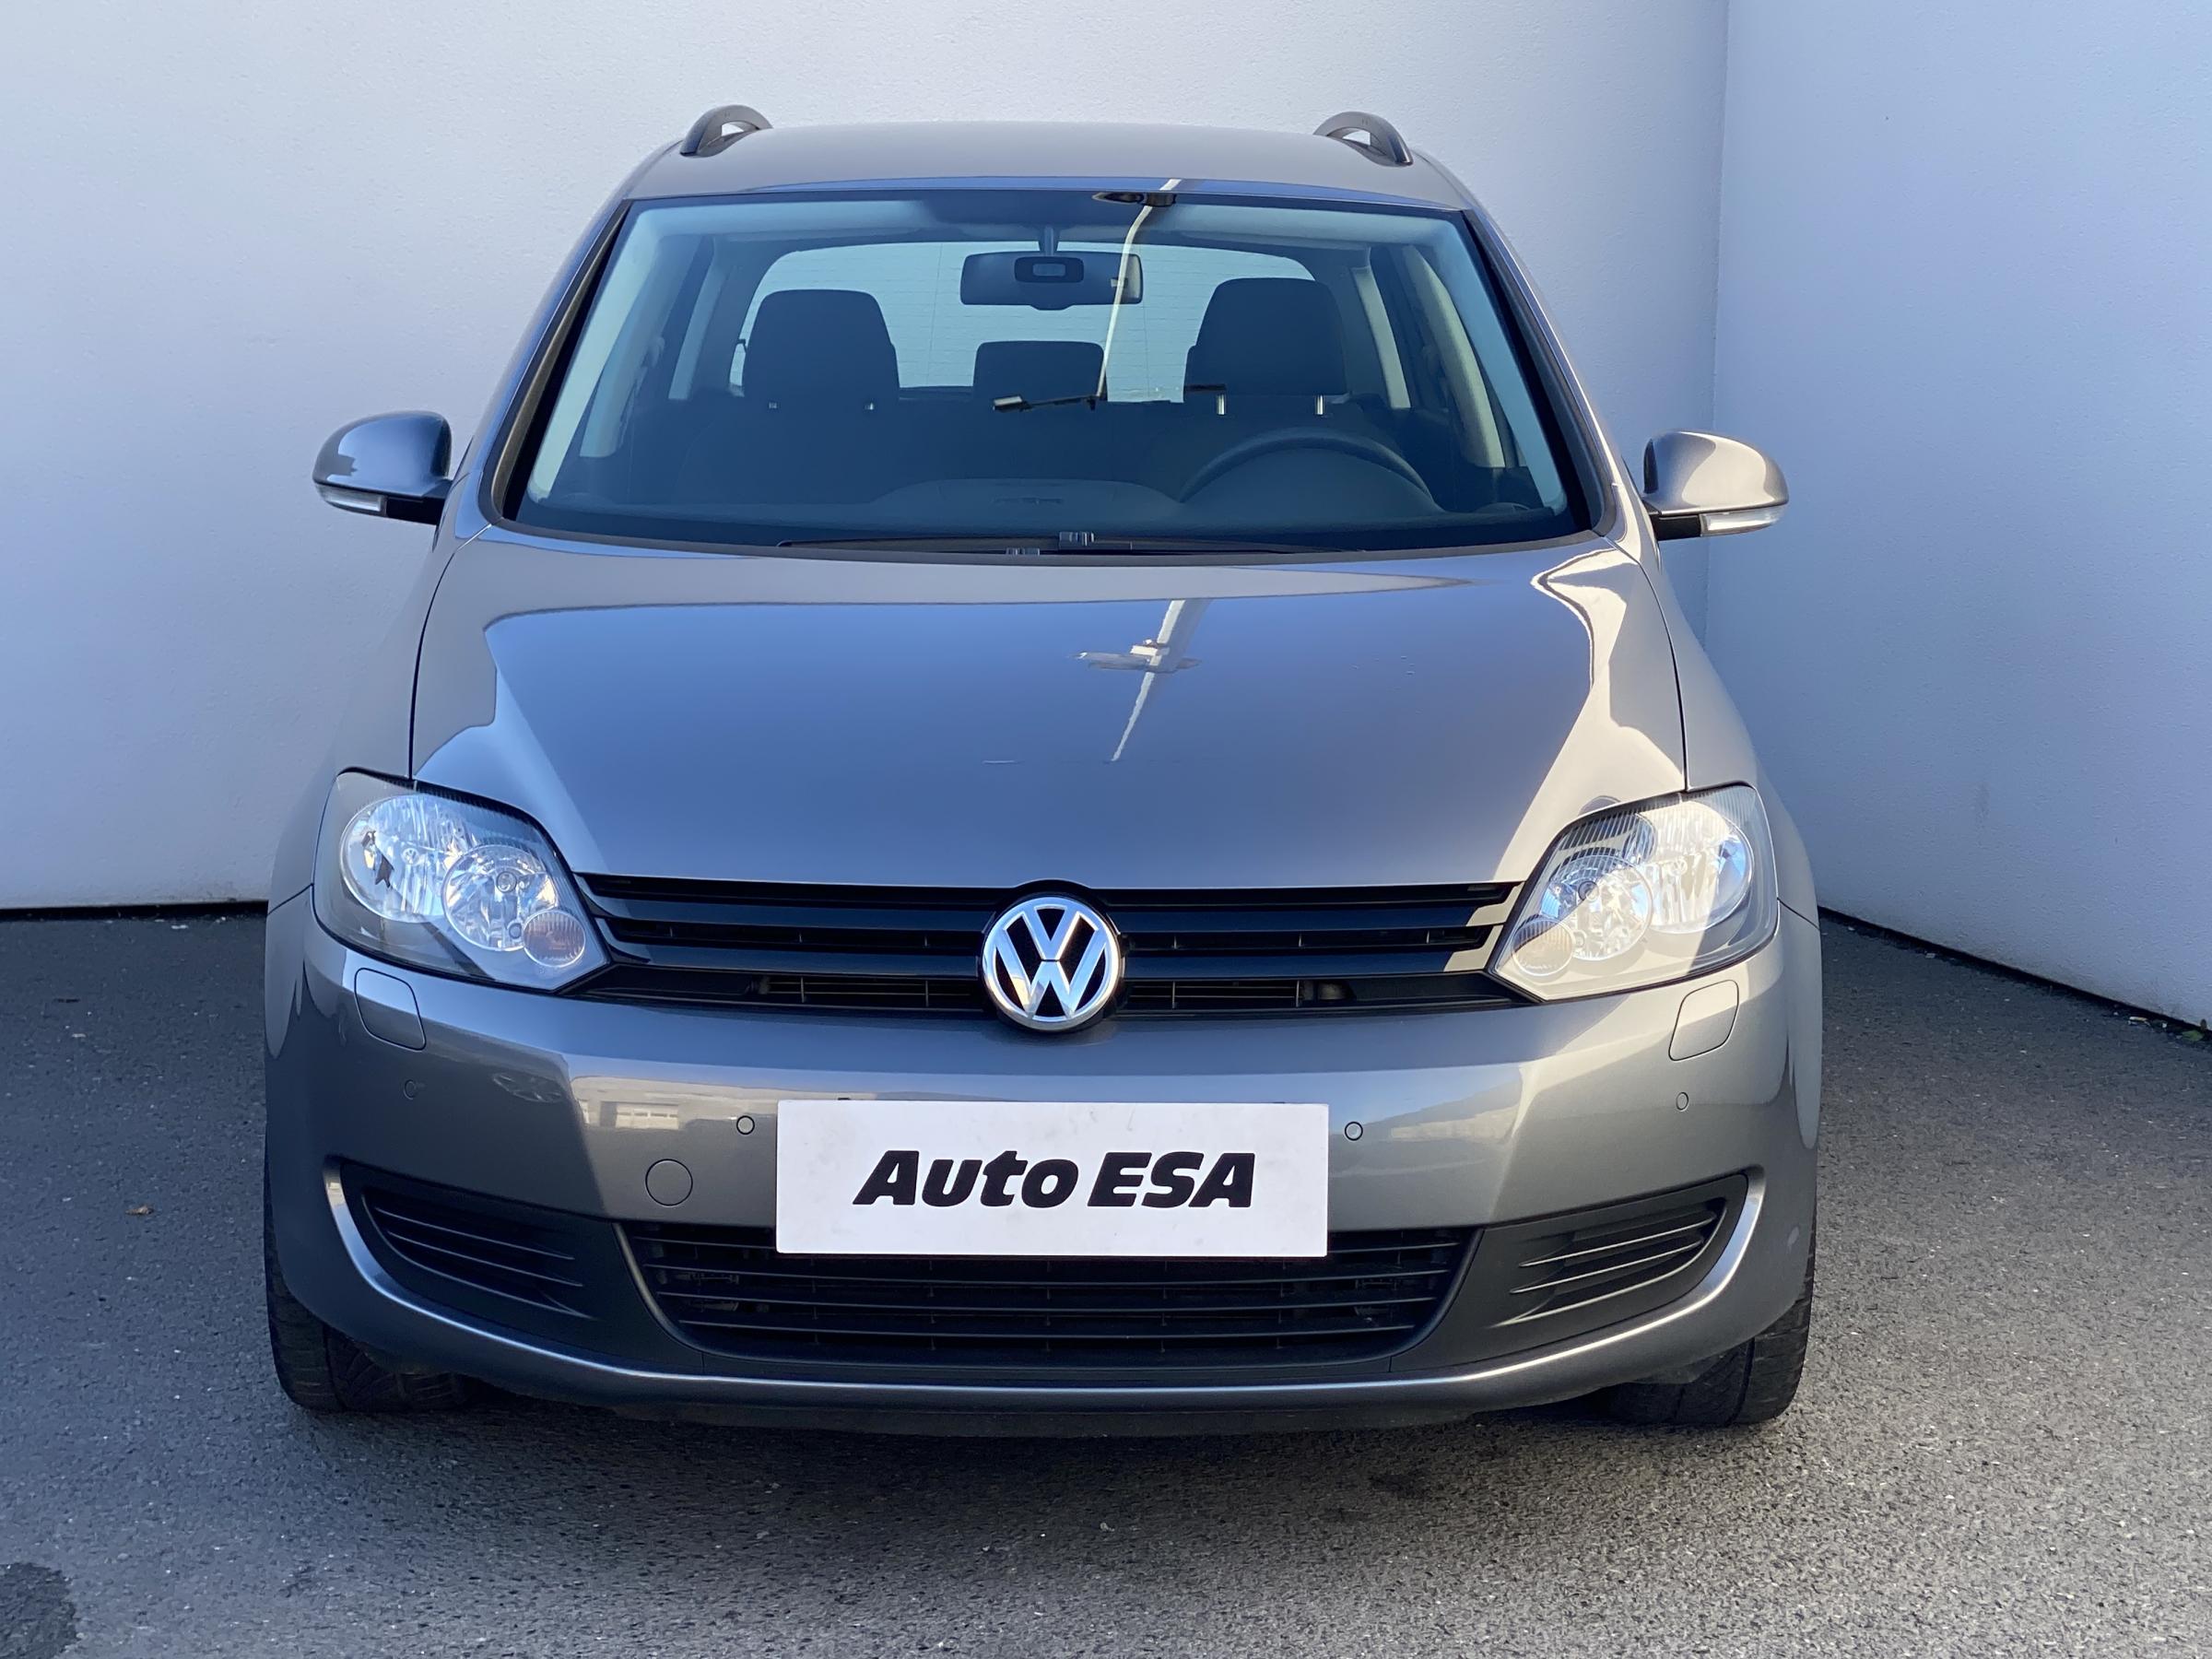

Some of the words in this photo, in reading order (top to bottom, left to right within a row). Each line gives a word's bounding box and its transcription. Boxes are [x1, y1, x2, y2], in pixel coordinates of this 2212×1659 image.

[985, 899, 1118, 1029] VW
[852, 1149, 1079, 1208] Auto
[1087, 1151, 1255, 1208] ESA
